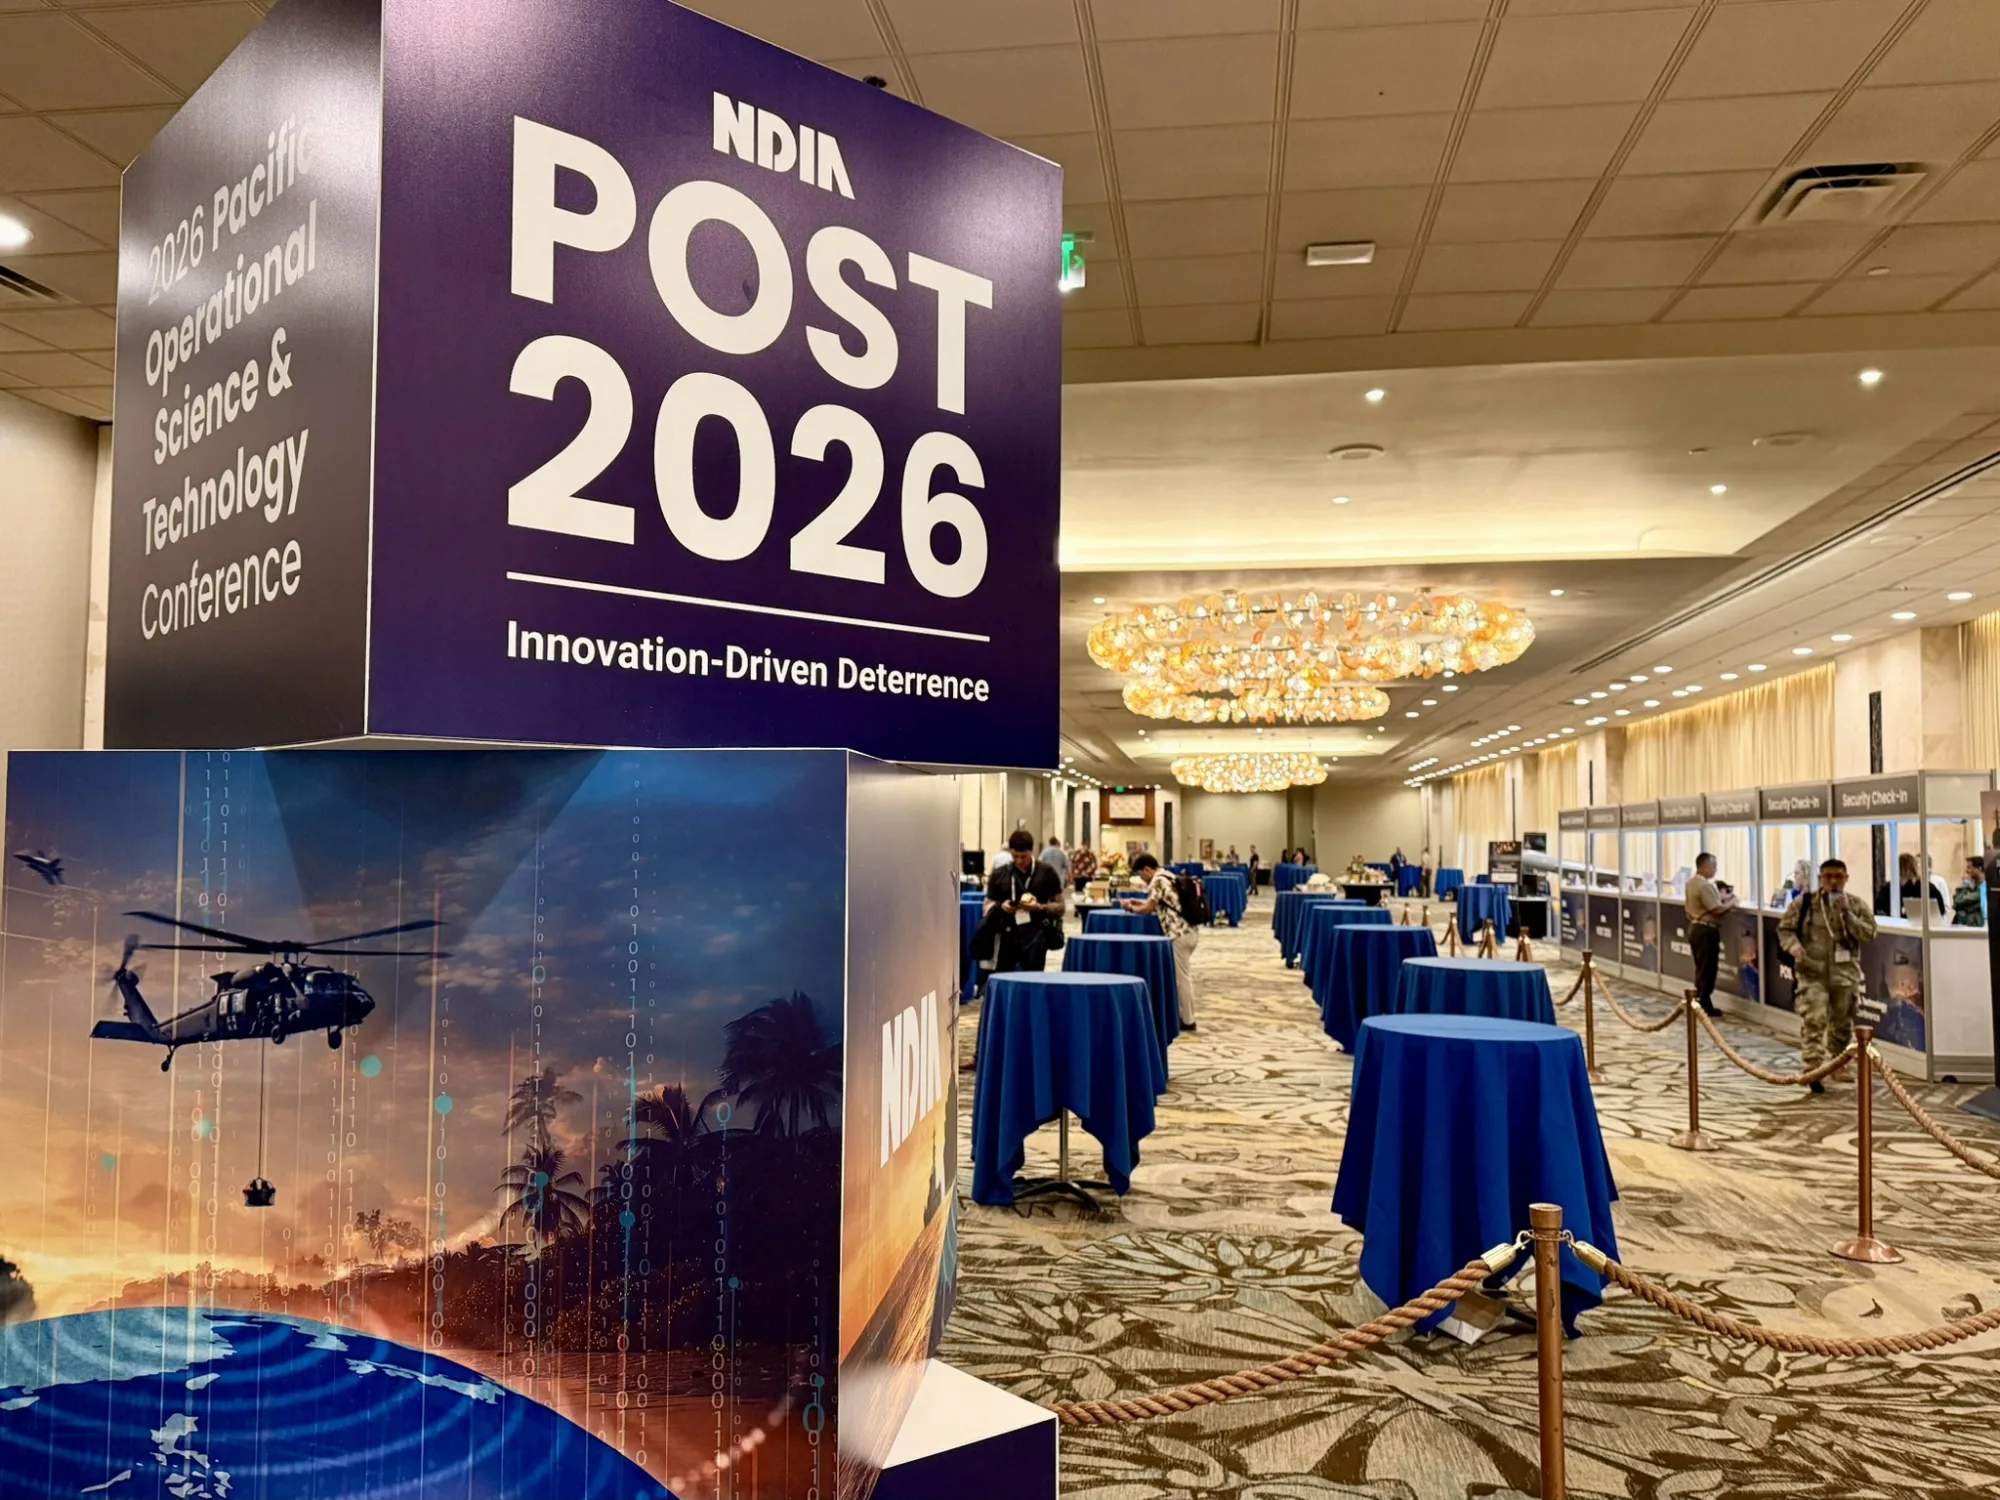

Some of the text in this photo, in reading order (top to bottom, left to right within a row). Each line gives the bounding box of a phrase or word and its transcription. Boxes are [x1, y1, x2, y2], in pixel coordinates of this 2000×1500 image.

[148, 112, 317, 305] 2026 Pacific
[713, 91, 856, 200] NDIA
[145, 199, 318, 397] Operational
[511, 114, 993, 415] POST
[153, 326, 294, 466] Science &
[508, 334, 988, 598] 2026
[142, 428, 310, 557] Technology
[141, 539, 302, 641] Conference
[507, 620, 990, 702] Innovation-Driven Deterrence
[1842, 790, 1870, 810] Security
[880, 989, 943, 1169] NDIA
